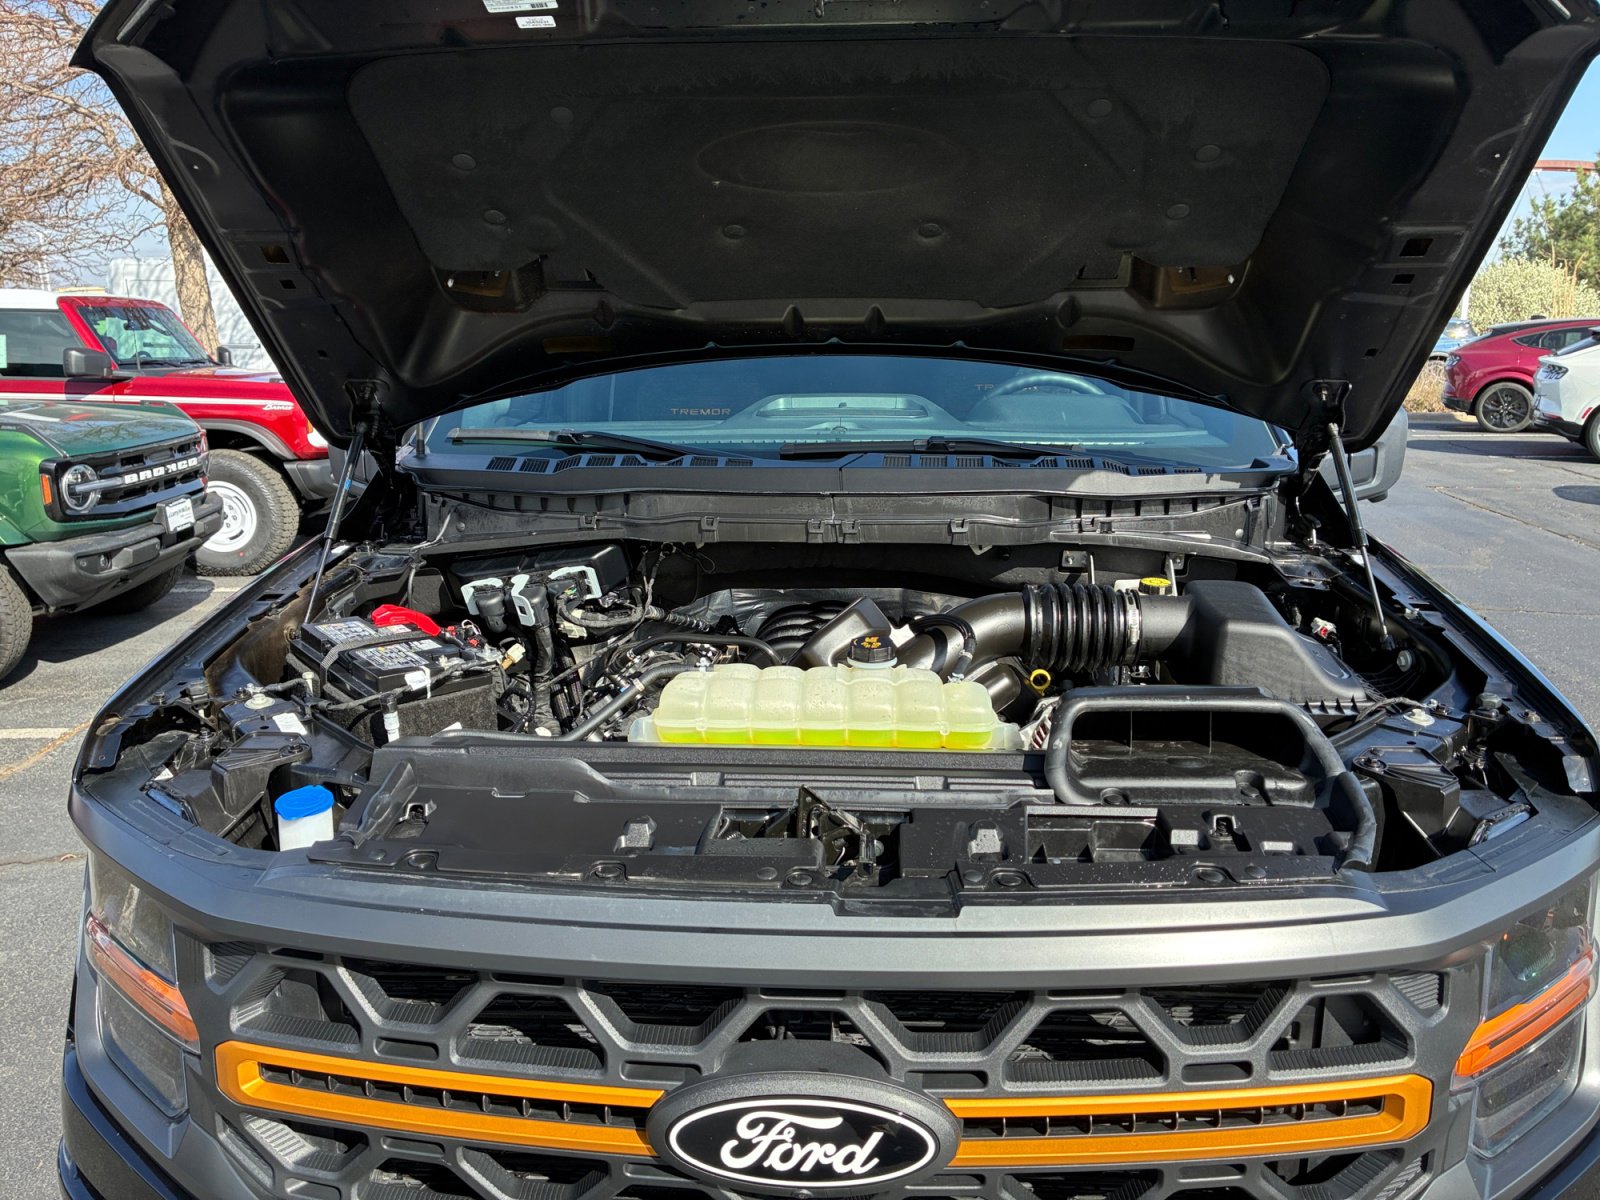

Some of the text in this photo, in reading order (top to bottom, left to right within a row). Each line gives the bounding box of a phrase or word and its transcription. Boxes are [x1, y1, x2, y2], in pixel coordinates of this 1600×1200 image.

[671, 408, 730, 416] TREMOR
[124, 457, 198, 485] BRONCO
[720, 1111, 884, 1174] Ford
